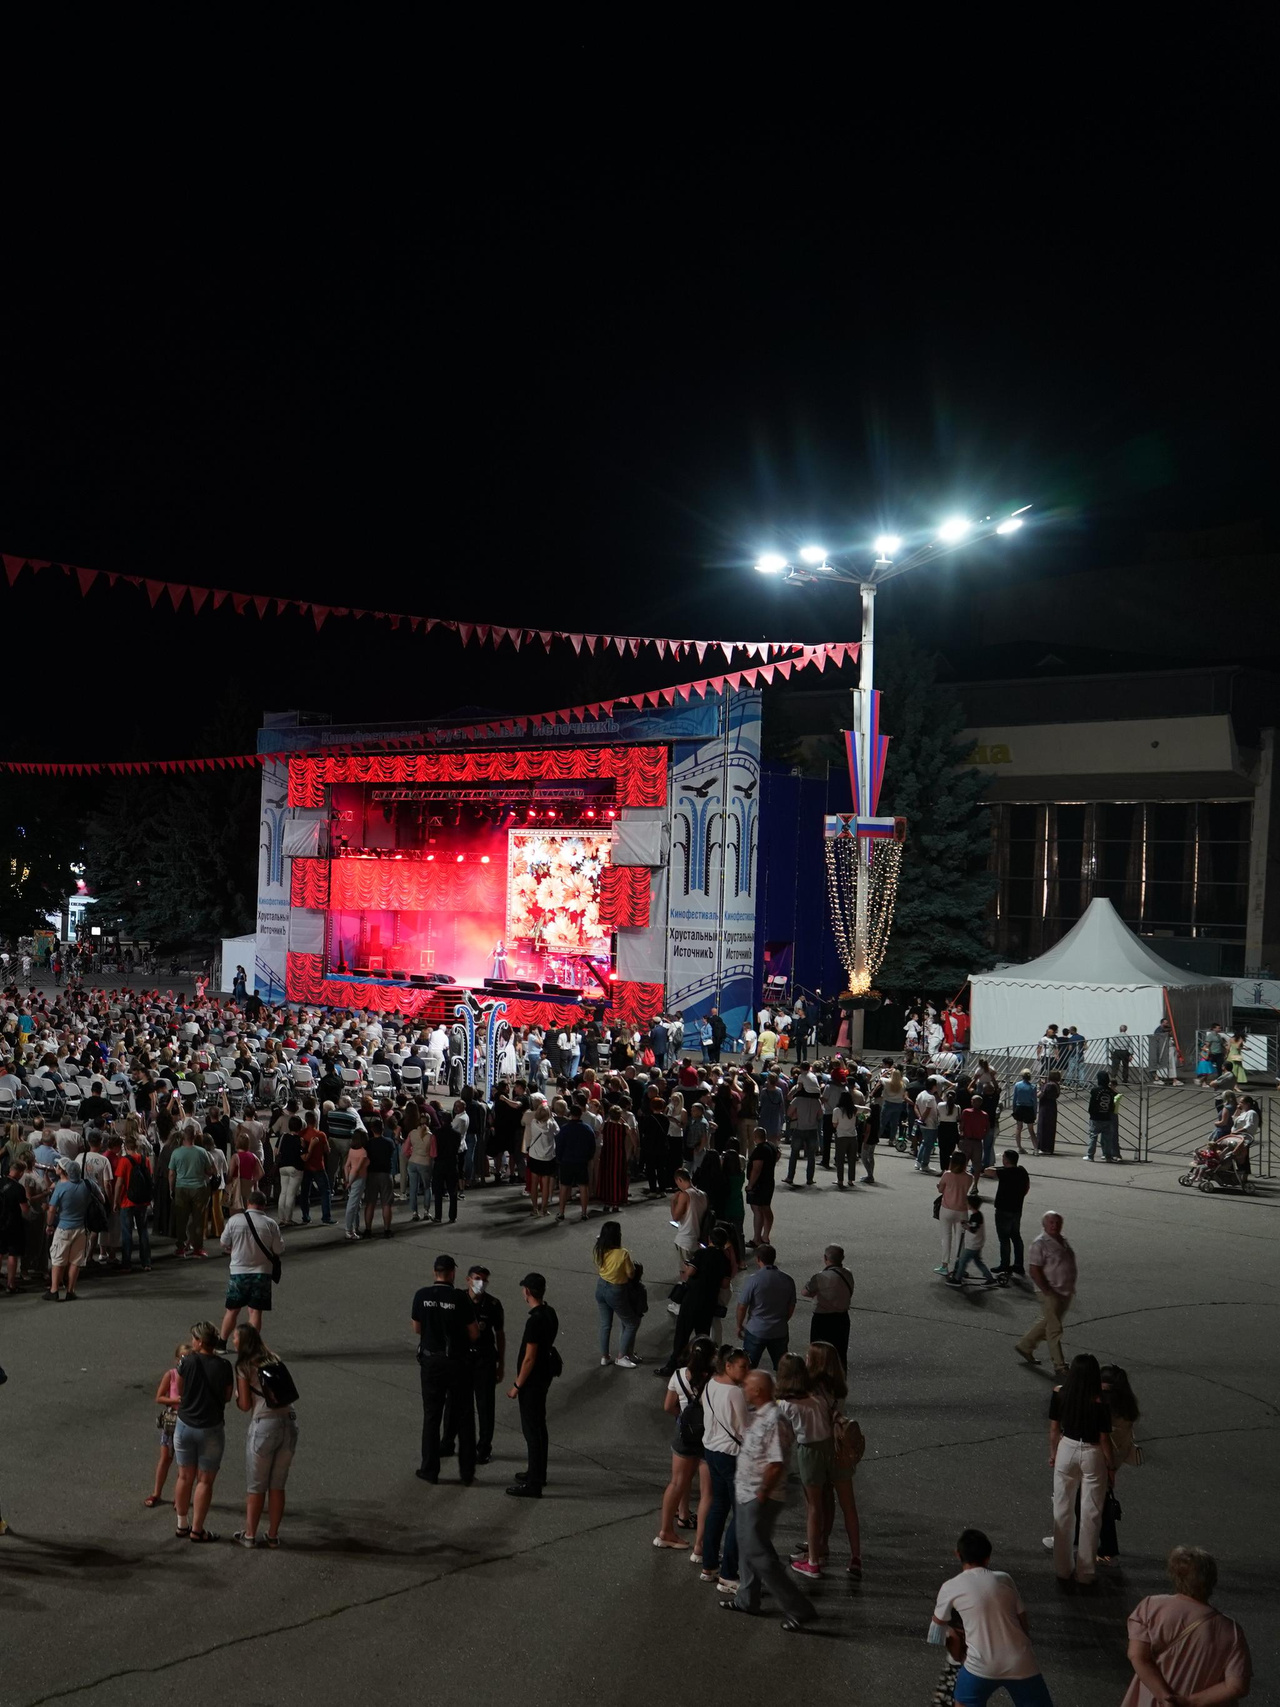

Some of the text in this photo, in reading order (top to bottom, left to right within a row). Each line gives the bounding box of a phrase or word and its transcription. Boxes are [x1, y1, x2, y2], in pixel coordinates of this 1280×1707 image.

[670, 908, 719, 921] Кинофестиваль
[669, 928, 718, 943] Хрустальный
[673, 944, 714, 959] ИсточникЪ
